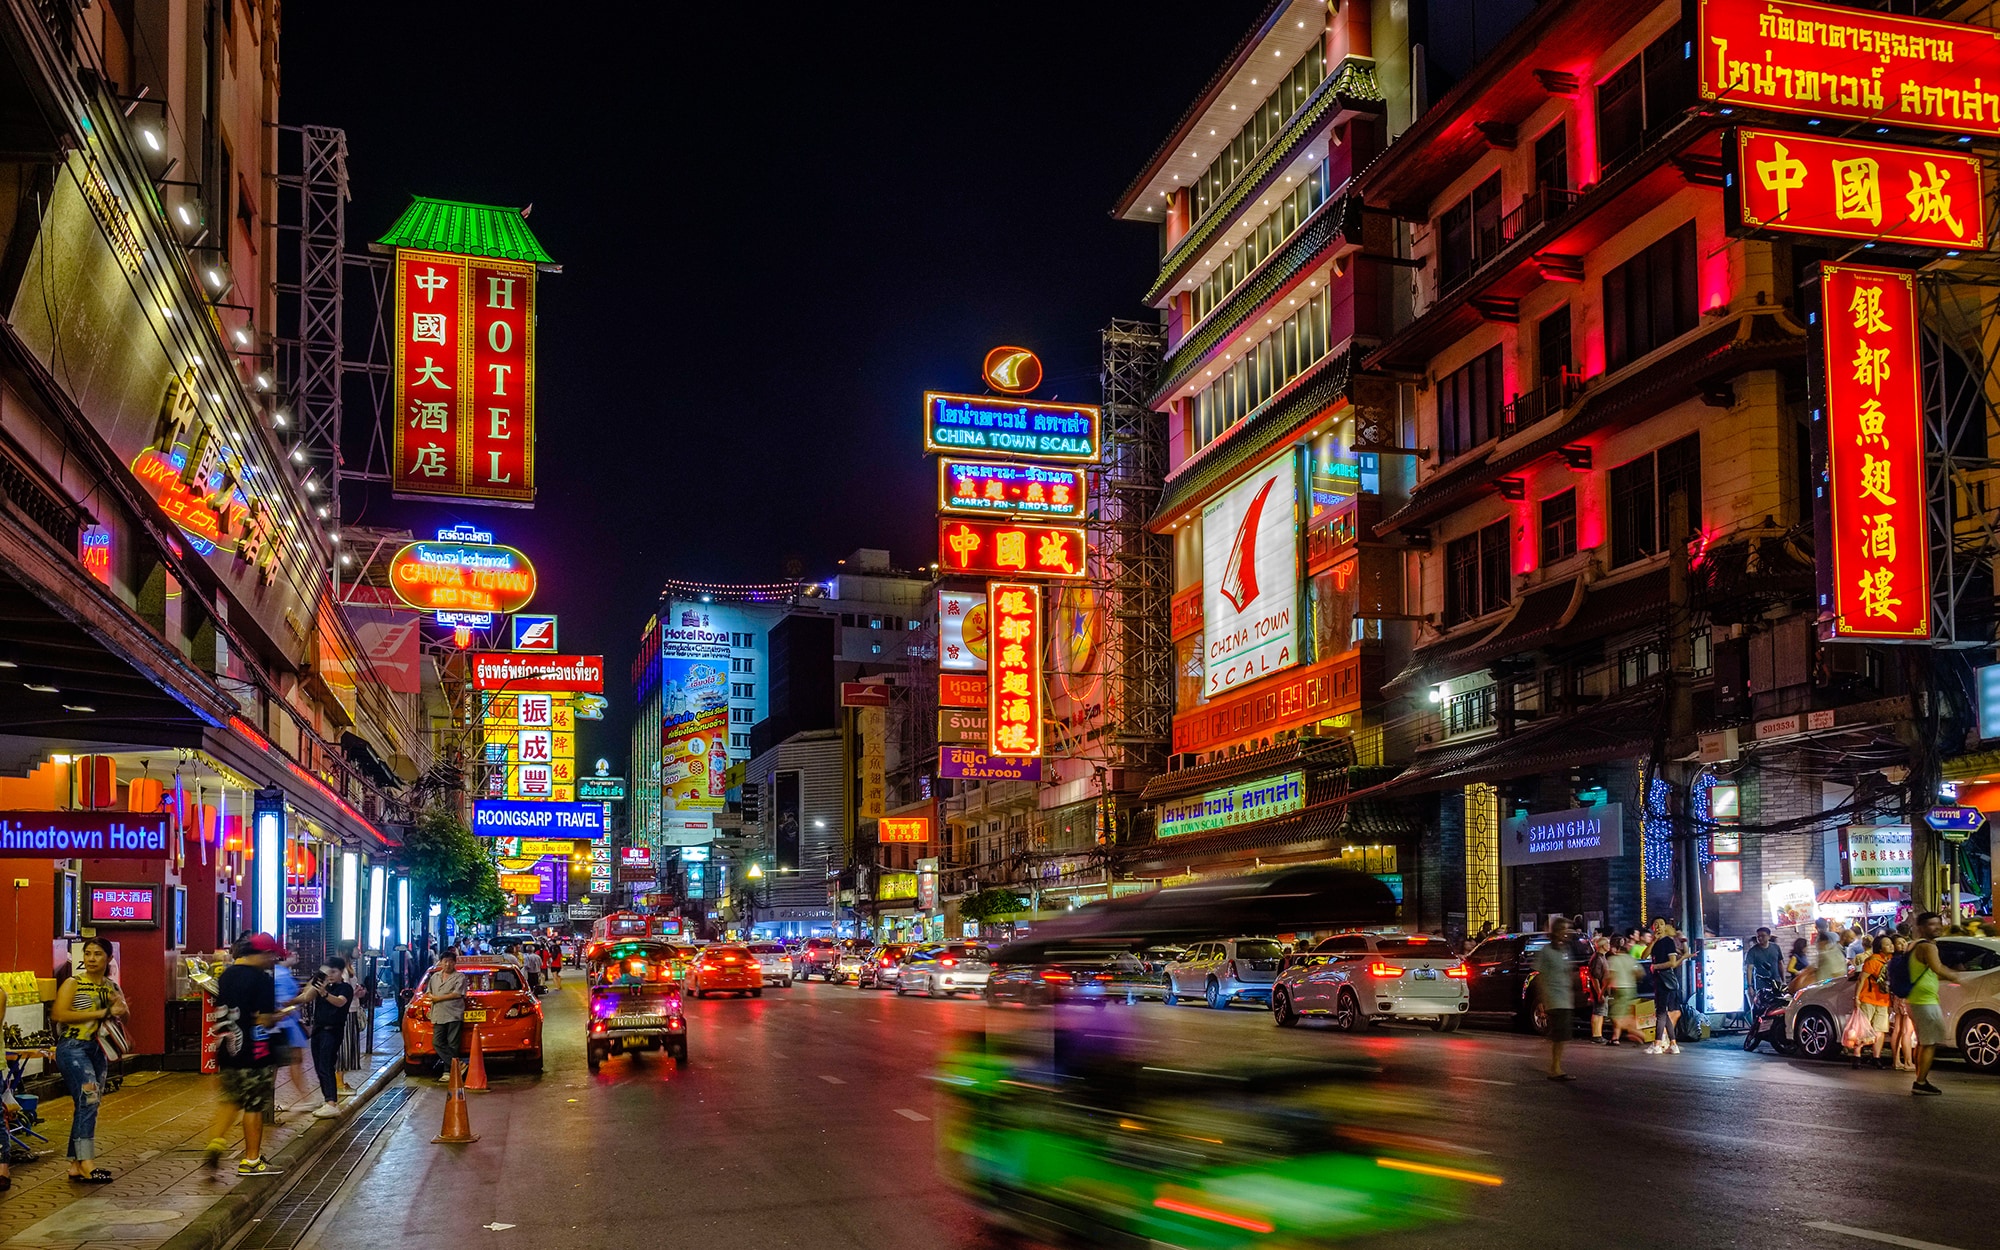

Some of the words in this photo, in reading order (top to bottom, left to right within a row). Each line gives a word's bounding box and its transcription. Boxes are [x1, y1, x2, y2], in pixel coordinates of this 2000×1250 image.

[1711, 36, 1884, 110] ไชน่าทาวน์
[1756, 141, 1964, 238] 中國城
[409, 266, 452, 477] 中國大酒店
[487, 277, 515, 483] HOTEL
[936, 429, 985, 445] CHINA
[990, 433, 1036, 449] TOWN
[1040, 437, 1092, 453] SCALA
[1848, 285, 1902, 623] 銀都魚翅酒樓
[952, 497, 991, 508] SHARK'S
[993, 500, 1009, 508] FIN
[1018, 503, 1049, 511] BIRD'S
[1051, 504, 1074, 513] NEST
[949, 524, 1074, 574] 中國城
[400, 564, 464, 586] CHINA
[470, 569, 528, 592] TOWN
[432, 588, 495, 608] HOTEL
[665, 628, 696, 641] Hotel
[697, 631, 730, 644] Royal
[1211, 627, 1249, 658] CHINA
[1254, 608, 1290, 637] TOWN
[997, 591, 1035, 751] 銀都魚翅酒樓
[1211, 646, 1290, 692] SCALA
[1762, 720, 1795, 734] SD13534
[522, 698, 549, 794] 振成豐
[664, 755, 674, 763] 20
[664, 775, 679, 784] 200
[961, 768, 1022, 778] SEAFOOD
[1161, 790, 1235, 824] ไชน่าทาวน์
[477, 810, 553, 826] ROONGSARP
[555, 812, 600, 827] TRAVEL
[1159, 825, 1179, 837] CHINA
[1181, 822, 1200, 833] TOWN
[1201, 817, 1225, 829] SCALA
[1968, 812, 1976, 825] 2
[0, 820, 103, 849] hinatown
[110, 821, 165, 849] Hotel
[1530, 819, 1600, 841] SHANGHAI
[1530, 840, 1564, 853] MANSION
[1567, 837, 1601, 849] BANGKOK
[93, 891, 152, 903] 中国大酒店
[110, 906, 135, 917] 欢迎
[287, 904, 319, 914] OTEL
